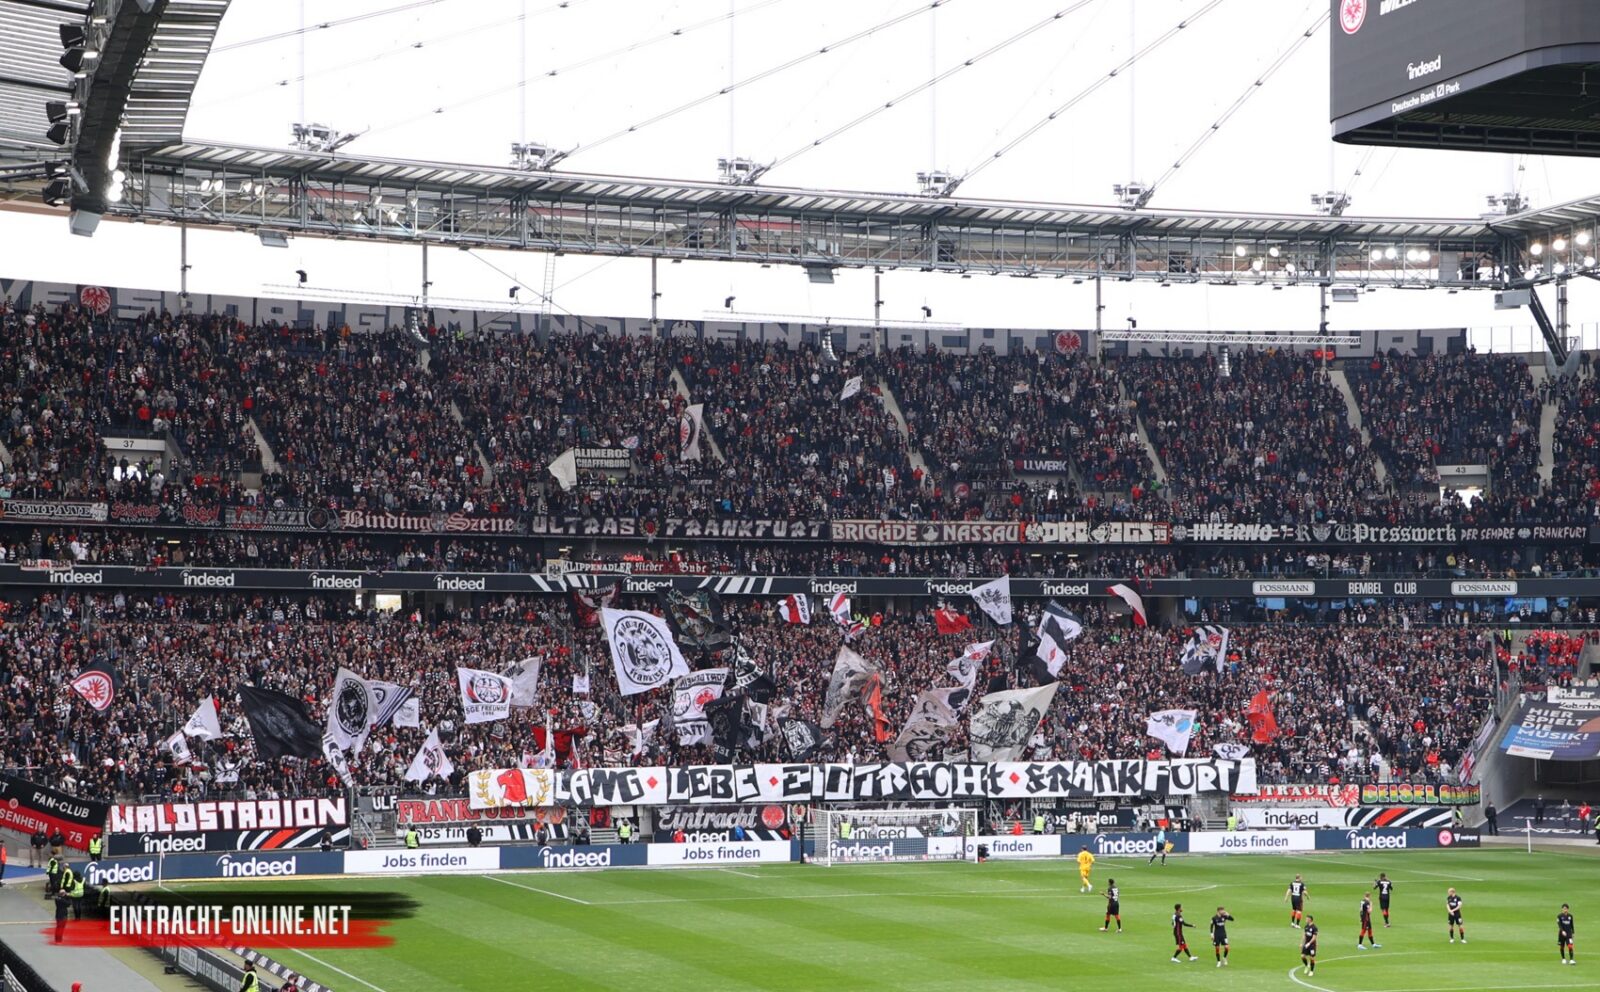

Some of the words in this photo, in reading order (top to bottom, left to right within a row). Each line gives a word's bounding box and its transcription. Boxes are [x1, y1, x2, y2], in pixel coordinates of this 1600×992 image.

[1407, 54, 1441, 80] indeed
[1392, 96, 1419, 113] Deutsche
[1421, 90, 1436, 103] Bank
[1446, 82, 1460, 95] Park
[123, 440, 134, 448] 37
[574, 448, 630, 458] ALIMEROS
[576, 458, 631, 468] CHAFFENBURG
[1456, 466, 1466, 474] 43
[3, 500, 92, 516] KUMPANE
[340, 509, 433, 532] Binding
[446, 509, 516, 532] Szene
[532, 516, 636, 536] ULTRAS
[665, 518, 826, 538] FRANKFURT
[832, 523, 918, 541] BRIGADE
[943, 524, 1019, 542] NASSAU
[1193, 523, 1273, 542] INFERNO
[1352, 523, 1457, 543] Presswerk
[1461, 528, 1478, 541] PER
[1480, 527, 1516, 541] SEMPRE
[1533, 527, 1588, 539] FRANKFURT
[563, 560, 632, 575] KLIPPENADLER
[50, 569, 103, 584] indeed
[183, 572, 235, 586] indeed
[313, 575, 362, 589] indeed
[437, 577, 485, 591] indeed
[626, 578, 673, 592] indeed
[811, 581, 857, 593] indeed
[927, 582, 974, 594] indeed
[1043, 583, 1089, 595] indeed
[1259, 584, 1310, 593] POSSMANN
[1348, 582, 1383, 595] BEMBEL
[1394, 582, 1417, 595] CLUB
[1458, 584, 1511, 593] POSSMANN
[1528, 707, 1574, 719] HIER
[1521, 721, 1554, 732] DIE
[1524, 714, 1588, 727] SPIELT
[1517, 727, 1590, 741] MUSIK!
[554, 768, 645, 805] LANG
[667, 764, 760, 801] LEBE
[782, 761, 1007, 801] EINTRACHT
[1025, 759, 1237, 796] FRANKFURT
[1256, 784, 1341, 796] TRACHT
[32, 791, 90, 818] FAN-CLUB
[111, 798, 346, 833] WALDSTADION
[658, 804, 757, 830] Eintracht
[69, 830, 83, 843] 75
[144, 834, 206, 853] indeed
[684, 830, 730, 843] ndeed
[1219, 835, 1248, 848] Jobs
[1250, 834, 1289, 847] finden
[1350, 831, 1407, 849] indeed
[831, 841, 894, 857] indeed
[992, 840, 1033, 852] finden
[1098, 835, 1157, 854] indeed
[382, 854, 417, 868] Jobs
[420, 853, 467, 867] finden
[543, 847, 611, 868] indeed
[682, 848, 714, 861] Jobs
[718, 846, 761, 859] finden
[88, 861, 154, 884] indeed
[222, 855, 296, 877] indeed
